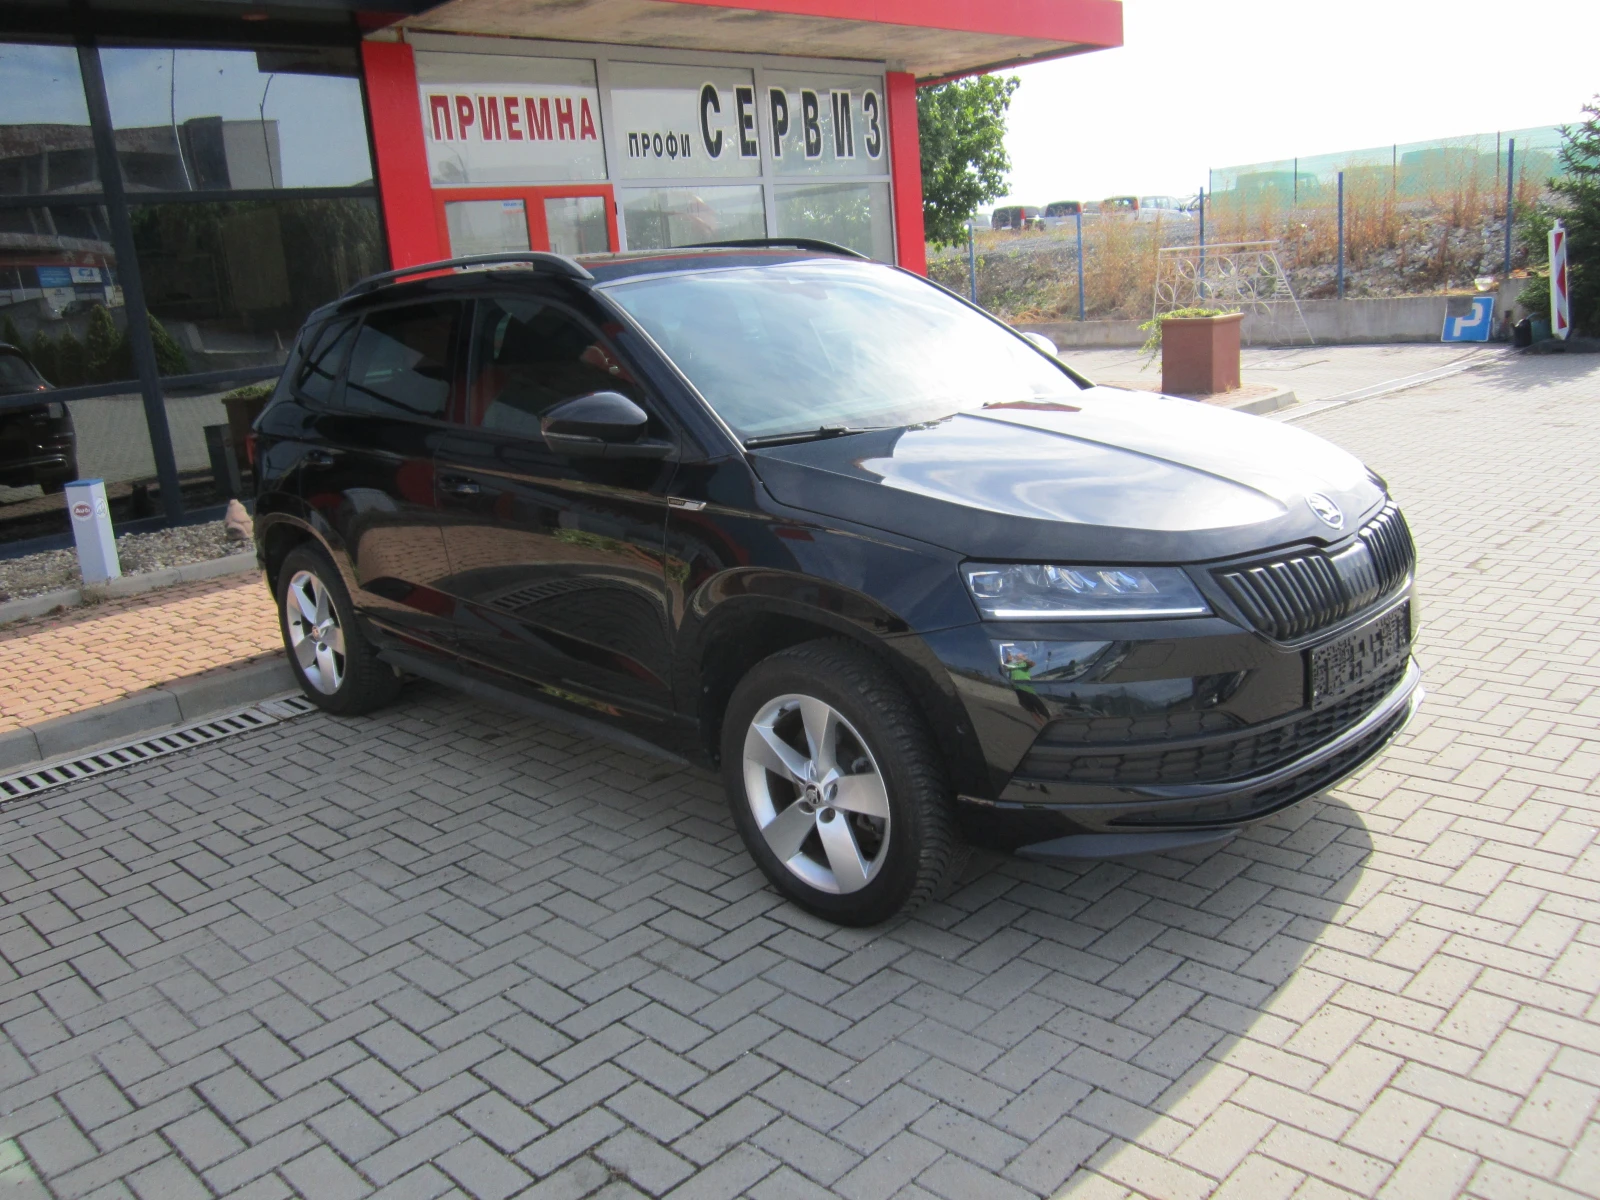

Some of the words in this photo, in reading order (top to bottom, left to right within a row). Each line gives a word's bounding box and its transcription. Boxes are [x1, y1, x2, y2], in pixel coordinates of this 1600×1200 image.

[429, 95, 598, 141] ПРИЕМНА
[628, 132, 691, 160] ПРОФИ
[700, 82, 882, 160] СЕРВИЗ
[1452, 302, 1483, 337] P
